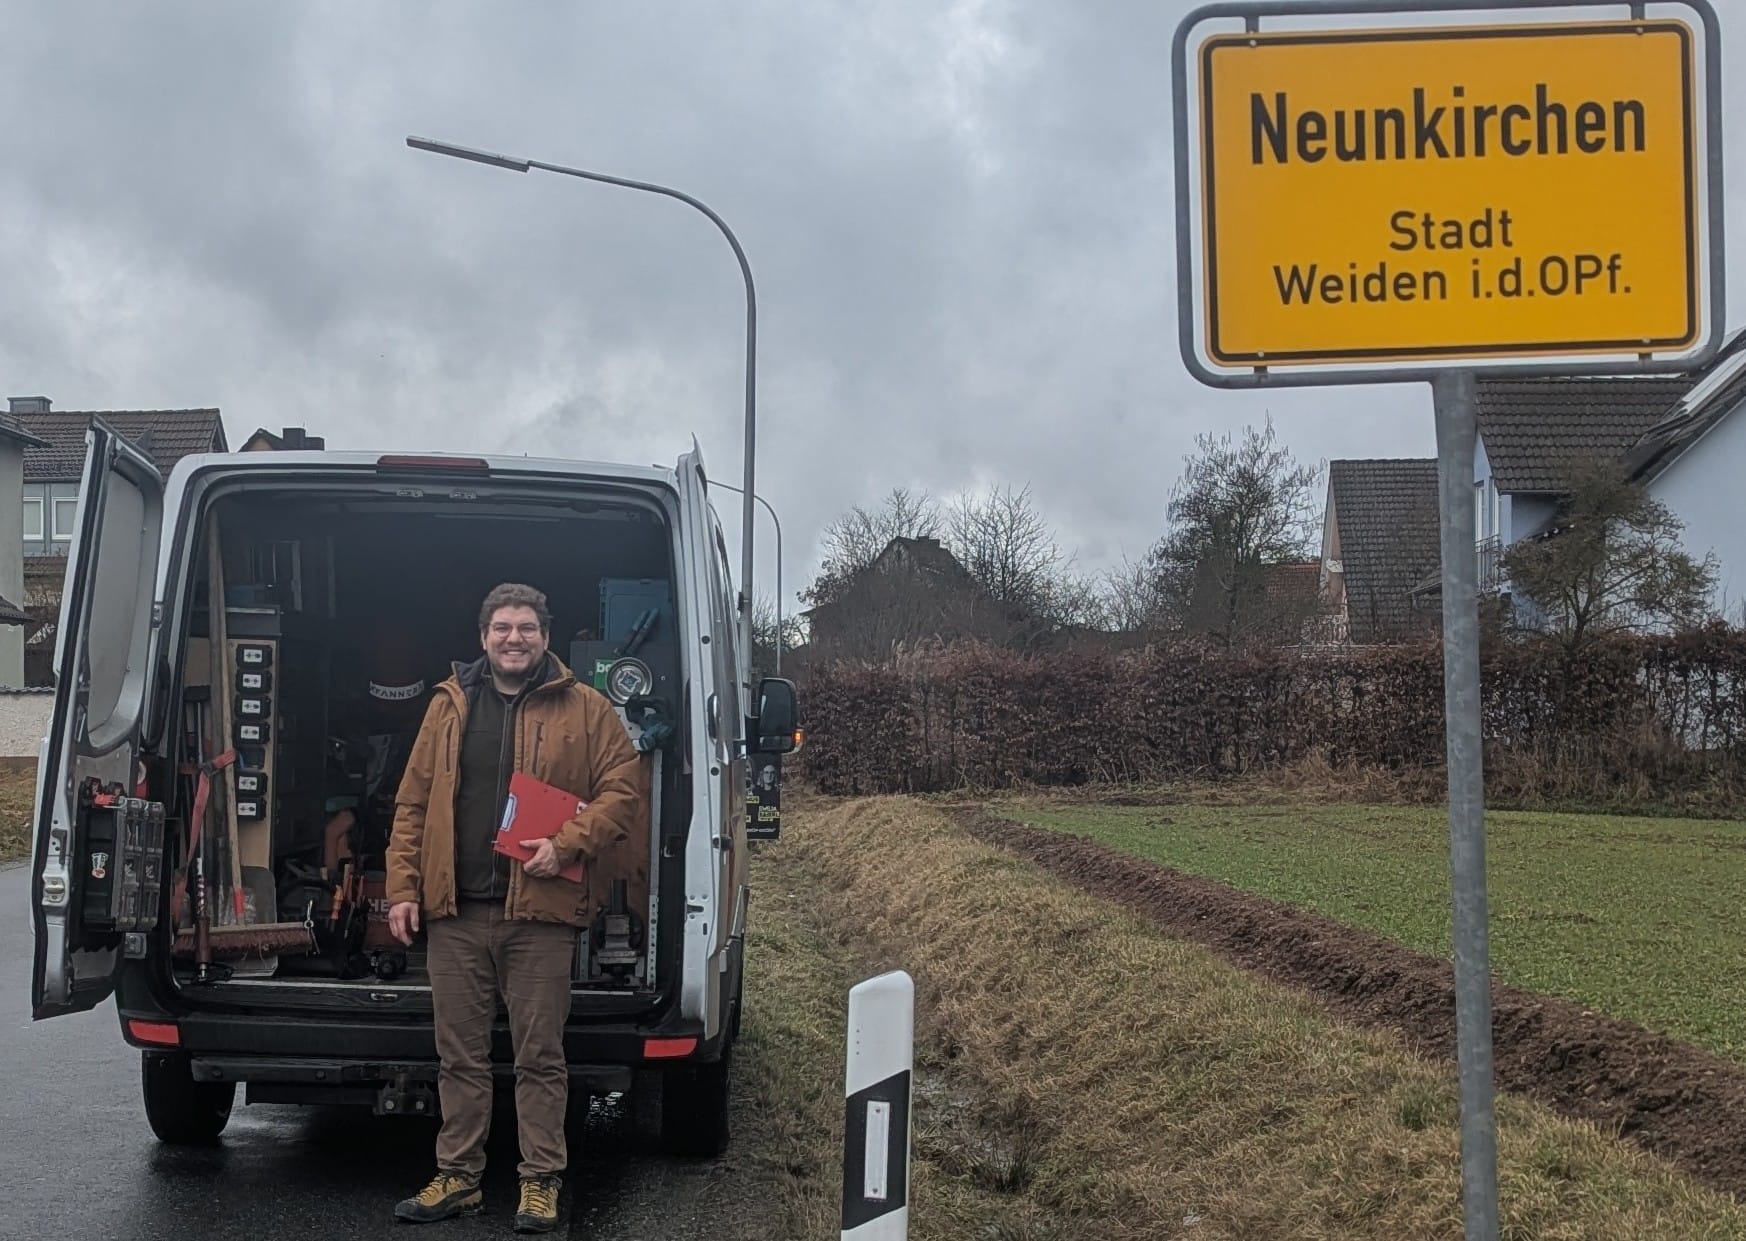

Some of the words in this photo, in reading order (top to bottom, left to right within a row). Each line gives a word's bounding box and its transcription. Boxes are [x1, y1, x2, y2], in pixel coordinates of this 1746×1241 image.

[1250, 83, 1646, 165] Neunkirchen
[1389, 207, 1513, 251] Stadt
[1273, 261, 1447, 306] Weiden
[1472, 253, 1632, 299] i.d.OPf.
